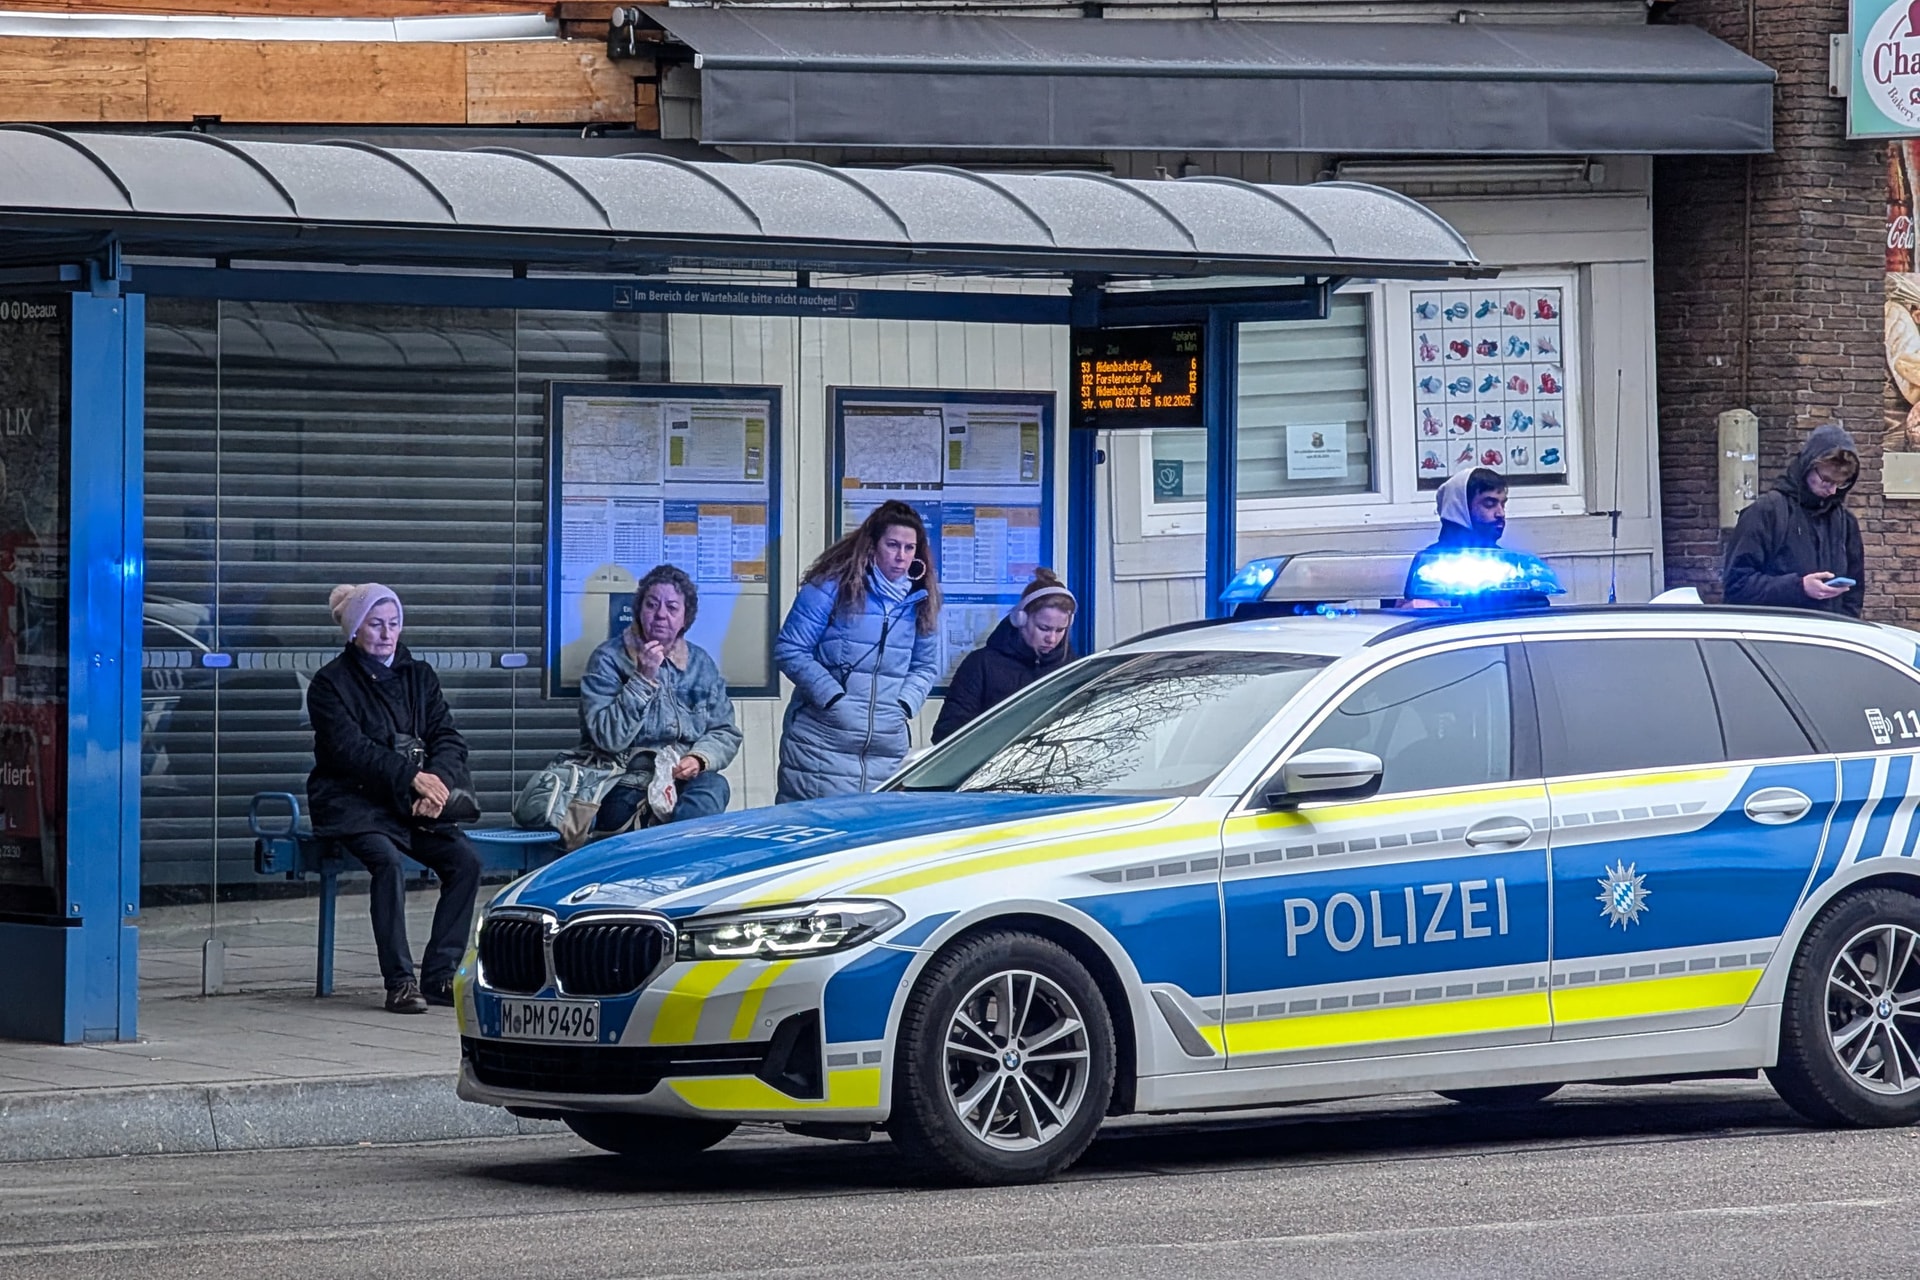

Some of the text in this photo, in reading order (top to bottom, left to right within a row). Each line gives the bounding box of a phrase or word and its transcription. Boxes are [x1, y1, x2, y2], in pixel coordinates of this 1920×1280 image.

[1873, 42, 1920, 84] Cha
[1888, 87, 1913, 122] Bakery
[634, 290, 837, 306] Im Bereich der Wartehalle bitte nicht rauchen!
[22, 302, 57, 319] Decaux
[1081, 361, 1091, 373] 53
[1191, 357, 1197, 370] 6
[1082, 374, 1094, 385] 132
[1095, 373, 1143, 385] Forstenrieder
[1145, 371, 1162, 383] Park
[1081, 386, 1091, 397] 53
[1140, 396, 1151, 408] bis
[6, 408, 33, 436] LIX
[1893, 709, 1920, 739] 11
[682, 824, 849, 845] OLIZEI
[1284, 878, 1509, 957] POLIZEI
[503, 1004, 595, 1037] M PM 9496
